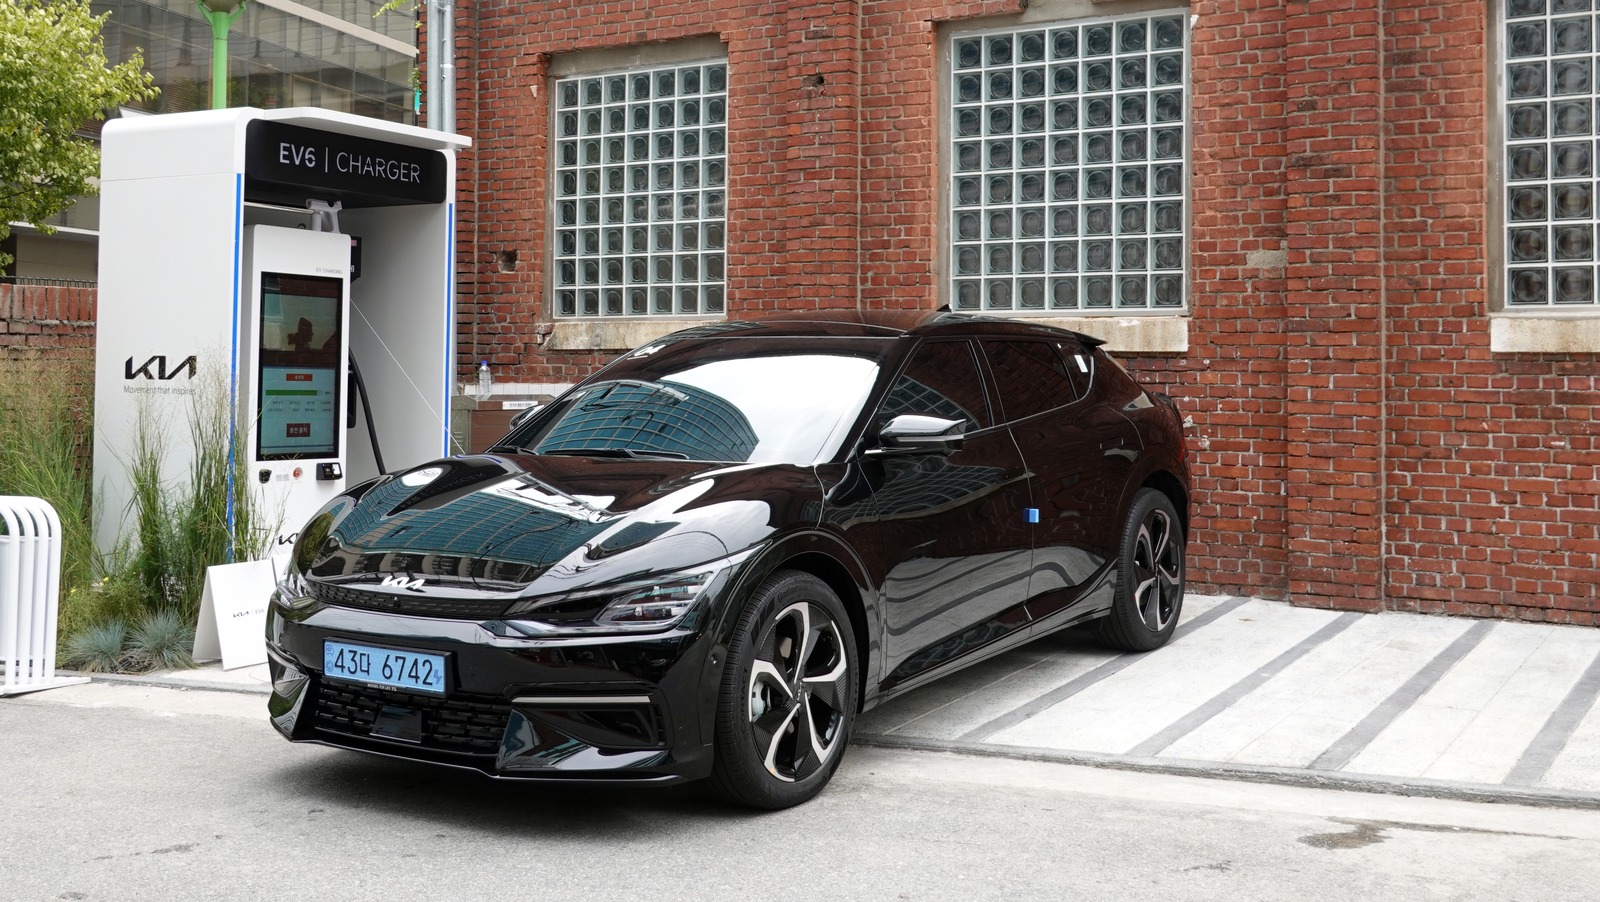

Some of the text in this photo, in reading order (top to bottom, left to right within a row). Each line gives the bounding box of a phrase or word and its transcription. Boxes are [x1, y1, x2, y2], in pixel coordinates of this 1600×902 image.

[279, 142, 421, 184] EV6 CHARGER
[125, 355, 197, 380] KIA
[381, 575, 425, 590] KIA
[232, 610, 249, 618] KIA
[334, 648, 433, 686] 43다 6742
